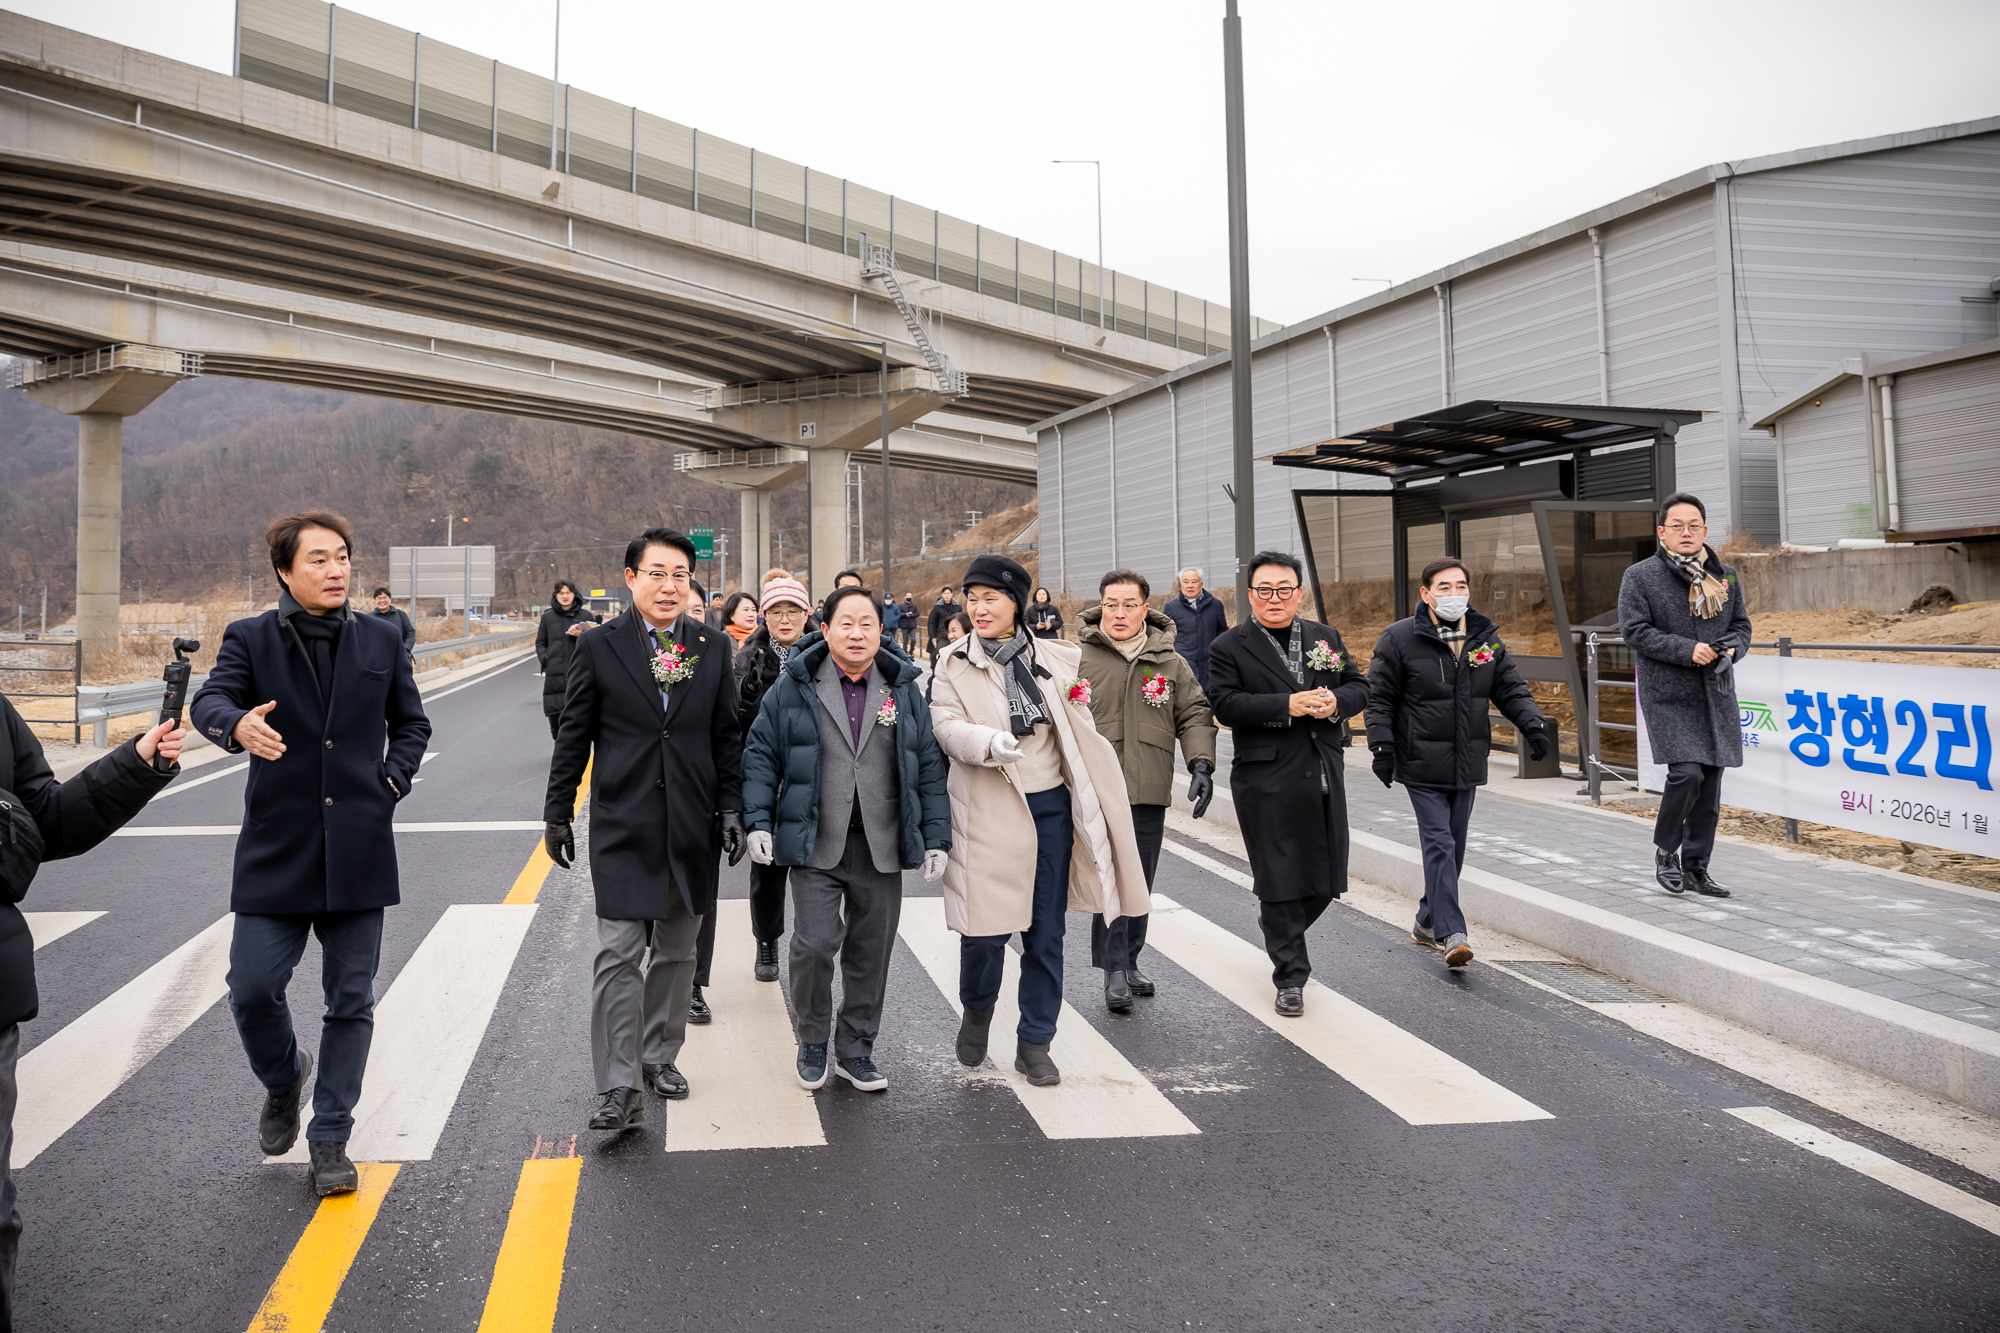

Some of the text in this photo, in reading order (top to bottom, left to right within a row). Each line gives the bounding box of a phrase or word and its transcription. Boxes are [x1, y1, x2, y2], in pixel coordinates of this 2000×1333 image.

[801, 424, 814, 437] P1
[1741, 731, 1760, 748] 양주
[1785, 689, 1994, 791] 창현2리
[1840, 790, 1873, 815] 일시
[1890, 799, 1951, 828] 2026년
[1961, 811, 1988, 835] 1월
